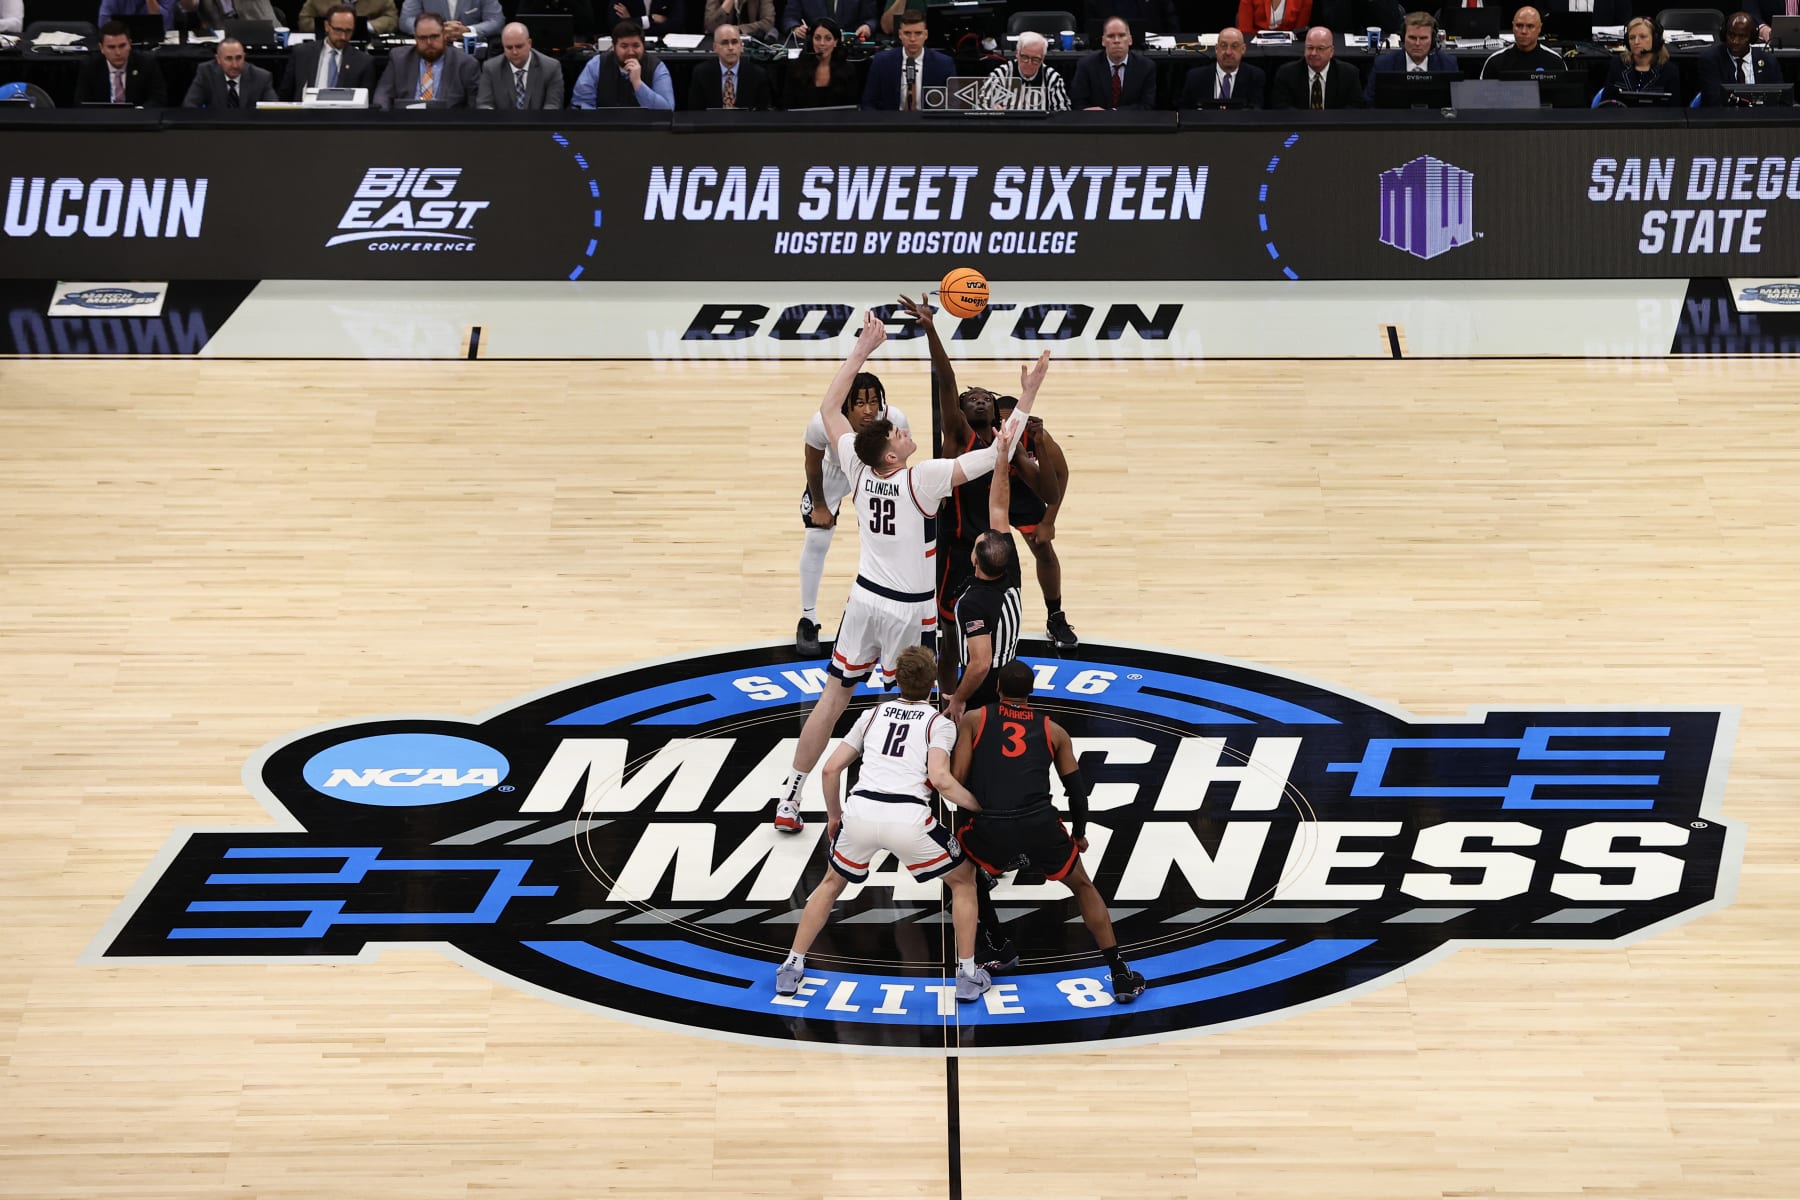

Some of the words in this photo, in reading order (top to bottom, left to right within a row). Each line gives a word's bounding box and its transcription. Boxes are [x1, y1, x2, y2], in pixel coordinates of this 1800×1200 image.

[354, 167, 463, 198] BIG
[644, 166, 780, 221] NCAA
[798, 166, 979, 221] SWEET
[990, 166, 1208, 221] SIXTEEN
[1588, 157, 1676, 201] SAN
[4, 178, 209, 238] UCONN
[338, 201, 490, 229] EAST
[367, 242, 476, 252] CONFERENCE
[774, 231, 857, 255] HOSTED
[863, 231, 893, 255] BY
[897, 231, 982, 255] BOSTON
[988, 231, 1078, 255] COLLEGE
[1639, 209, 1767, 254] STATE
[681, 304, 1184, 340] BOSTON
[865, 479, 900, 497] CLINGAN
[869, 497, 896, 536] 32
[1032, 664, 1118, 695] 16
[883, 706, 925, 720] SPENCER
[999, 704, 1034, 721] PARRISH
[881, 722, 910, 758] 12
[1001, 721, 1027, 758] 3
[322, 767, 500, 788] NCAA
[518, 737, 1303, 814] MACH
[770, 977, 1026, 1017] ELITE
[1056, 977, 1116, 1009] 8
